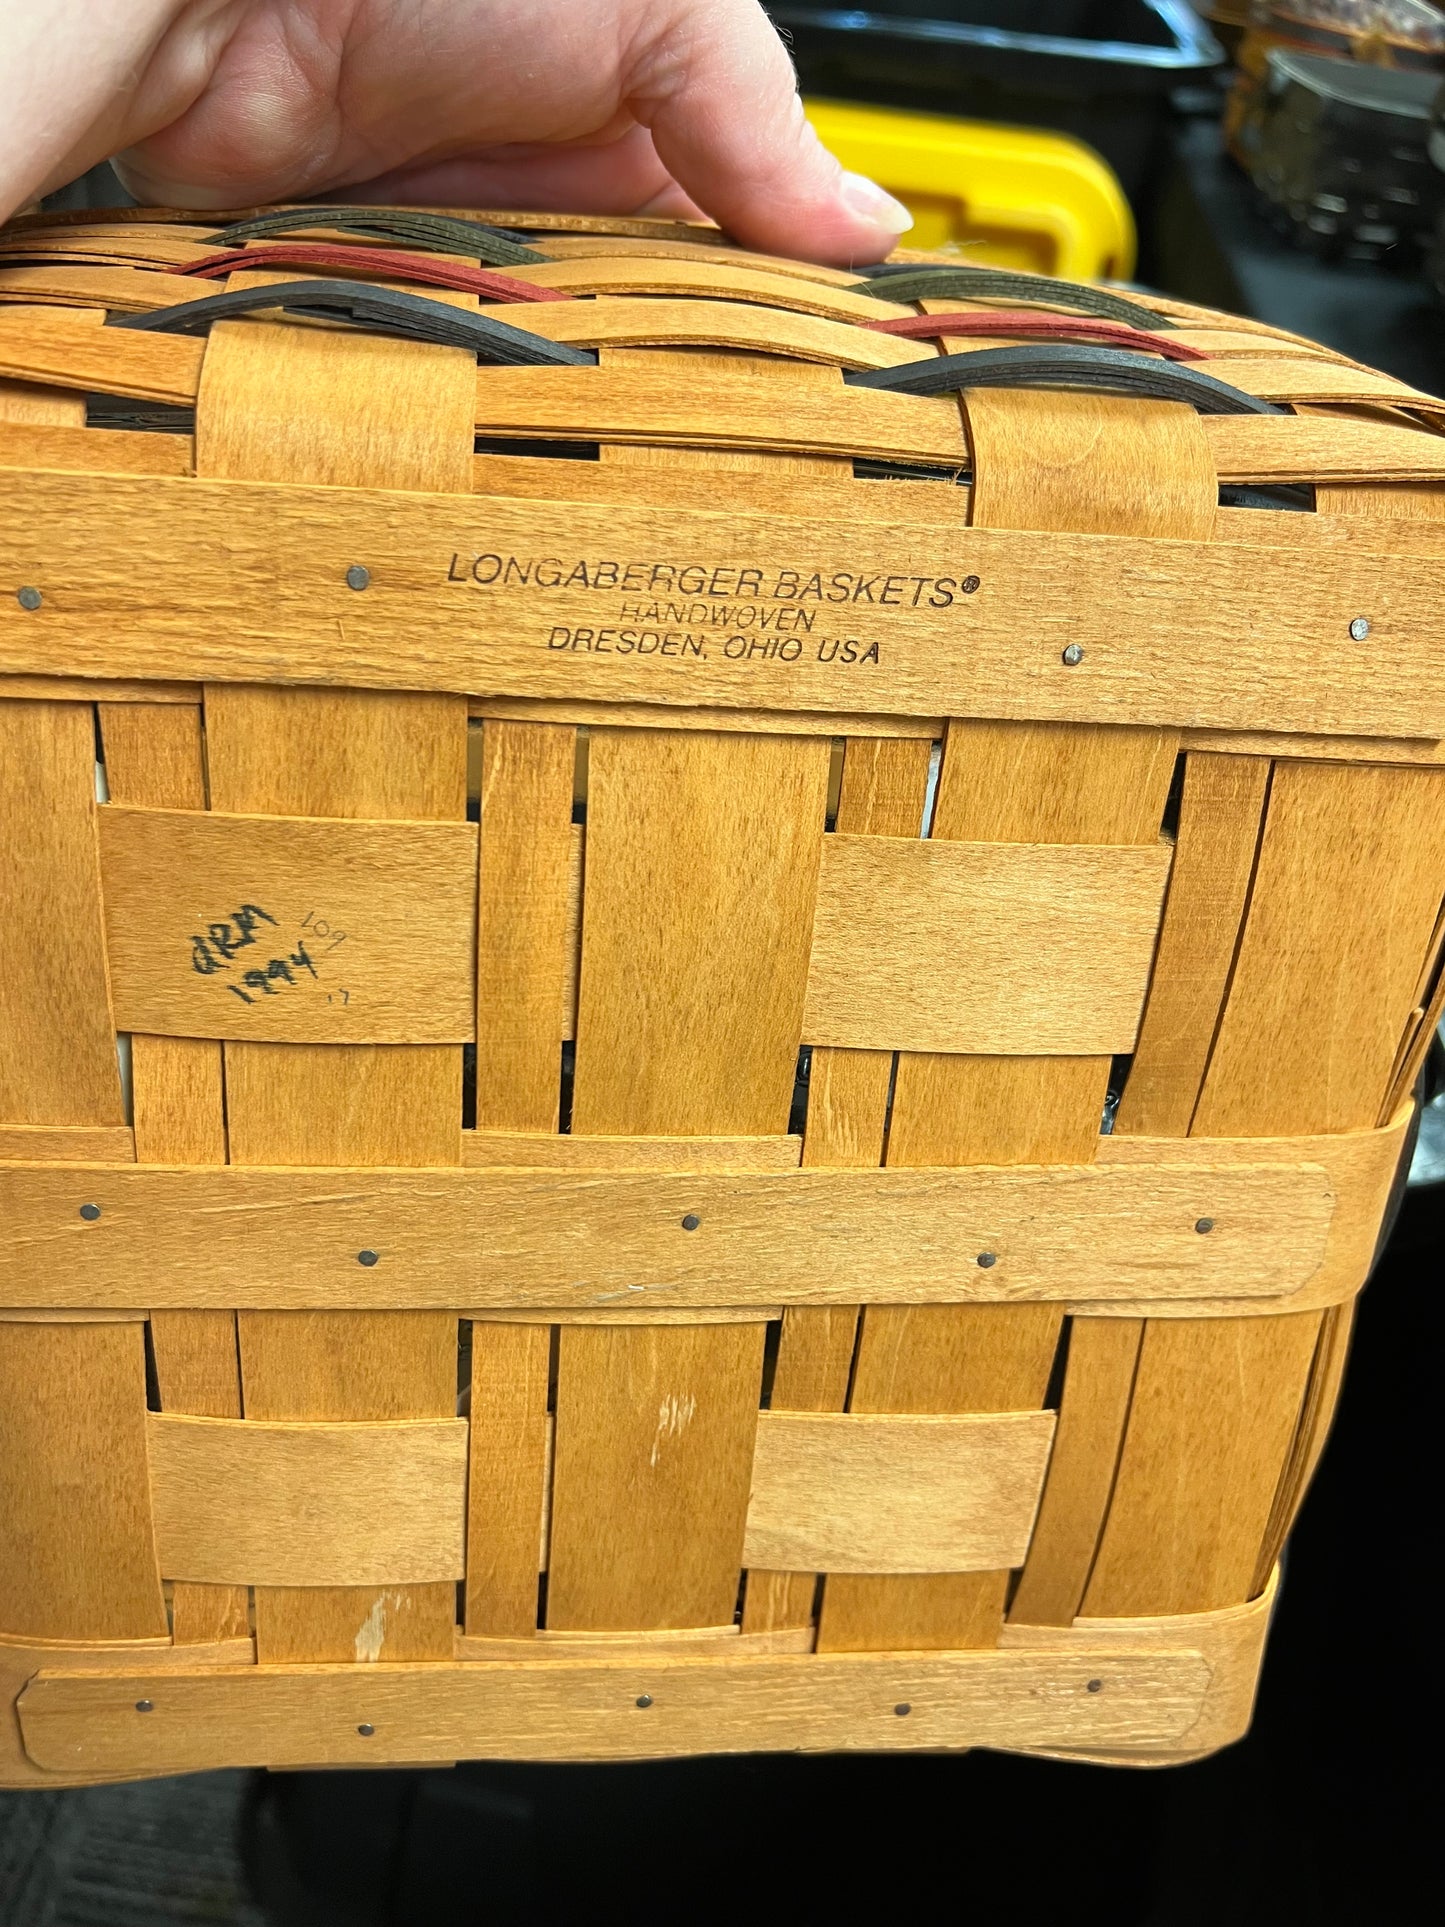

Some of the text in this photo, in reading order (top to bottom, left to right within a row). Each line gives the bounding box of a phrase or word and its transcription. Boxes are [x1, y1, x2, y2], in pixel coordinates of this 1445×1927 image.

[448, 553, 763, 597] LONGABERGER
[620, 601, 817, 632] HANDWOVEN
[548, 627, 880, 664] DRESDEN, OHIO USA
